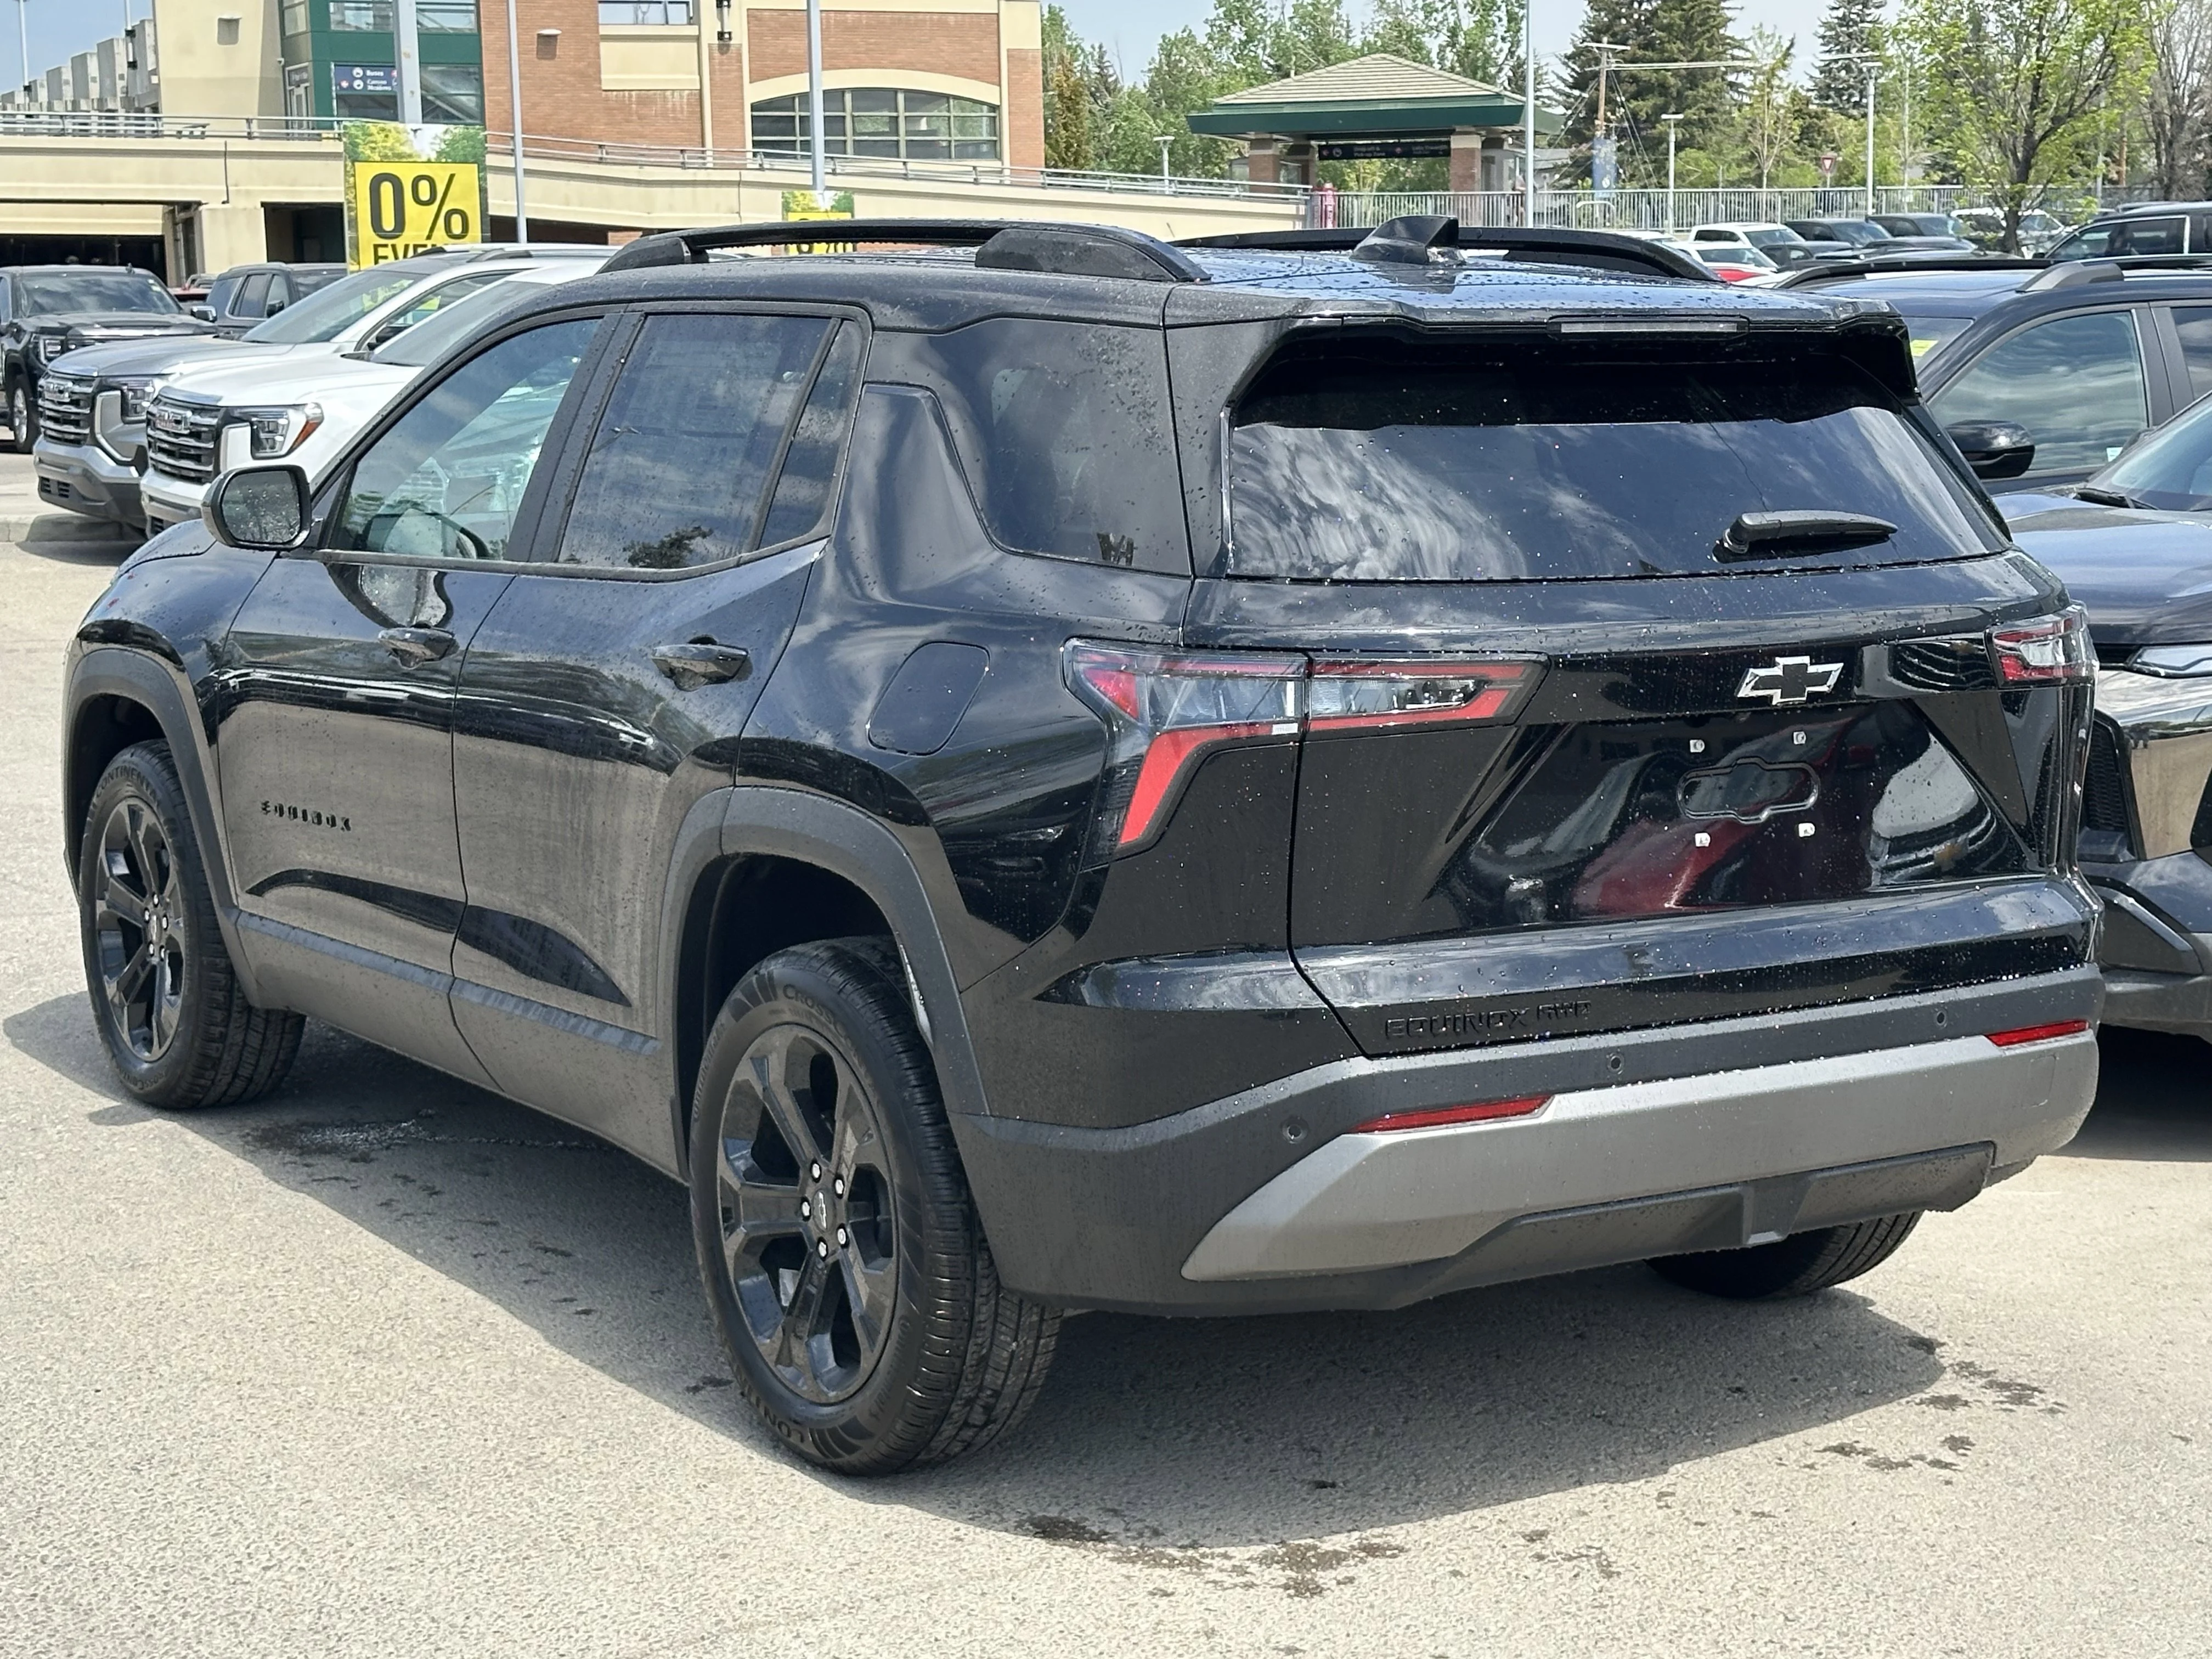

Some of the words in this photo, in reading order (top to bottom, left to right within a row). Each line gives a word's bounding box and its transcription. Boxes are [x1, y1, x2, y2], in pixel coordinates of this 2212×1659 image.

[369, 172, 470, 240] 0%
[261, 800, 351, 832] EQUINOX
[1384, 1007, 1530, 1040] EQUINOX
[1537, 1000, 1591, 1022] AWD
